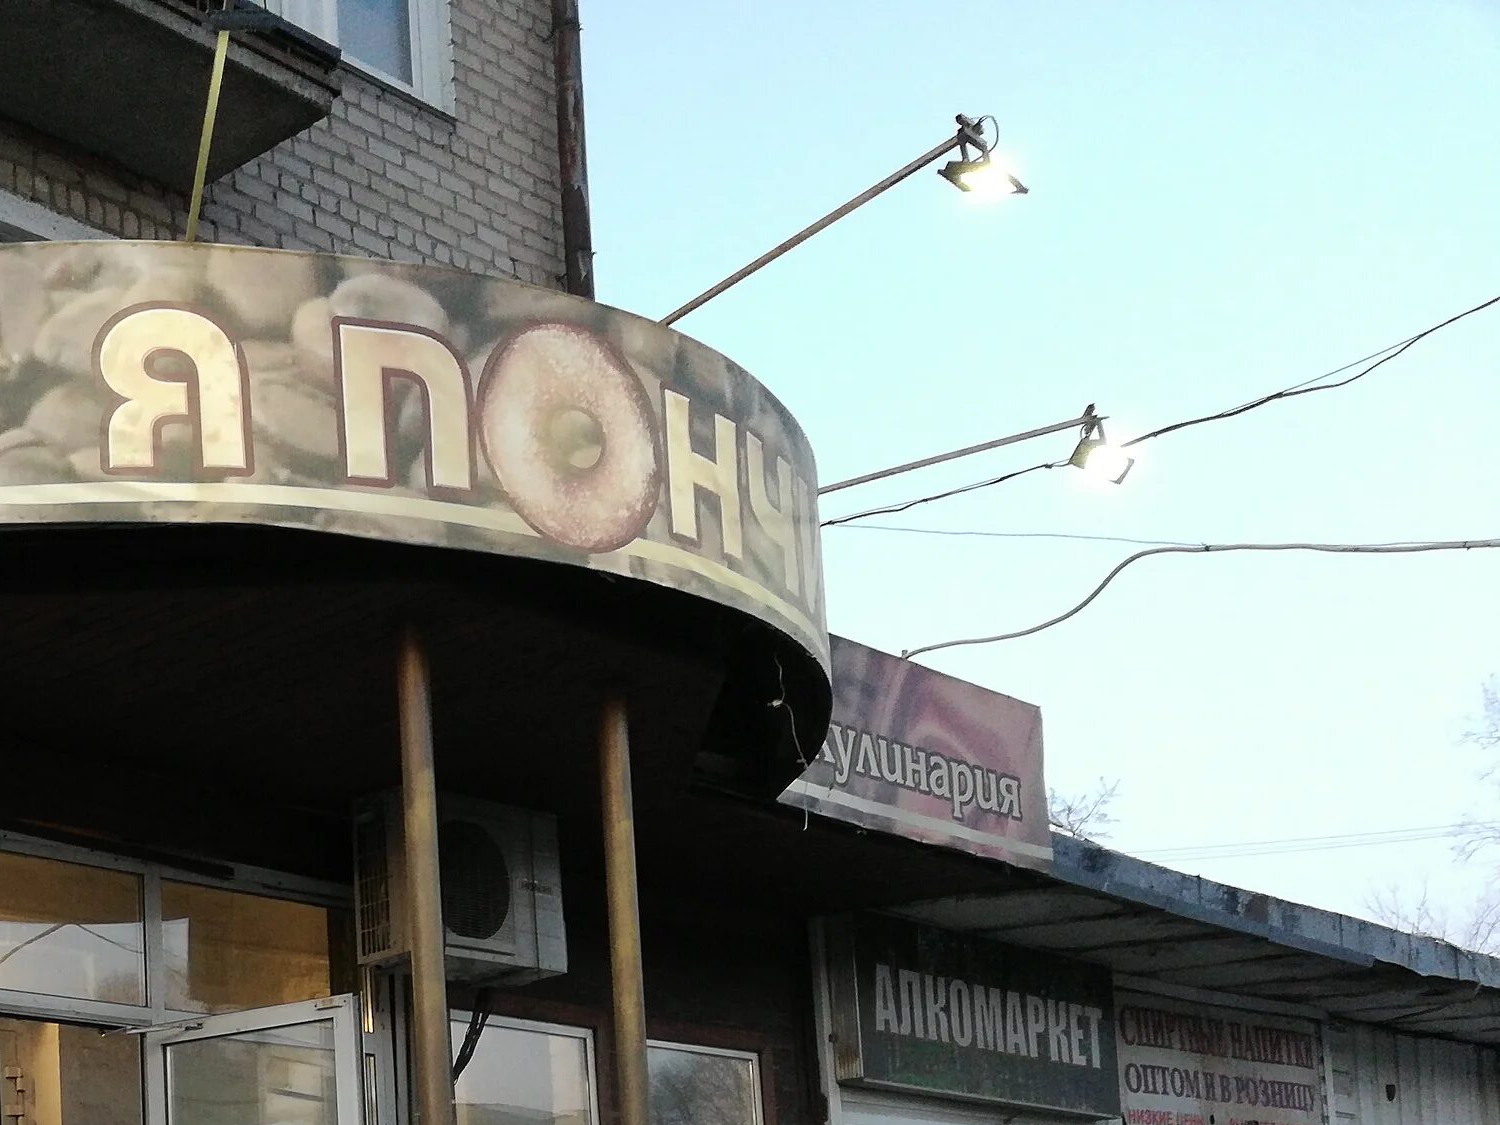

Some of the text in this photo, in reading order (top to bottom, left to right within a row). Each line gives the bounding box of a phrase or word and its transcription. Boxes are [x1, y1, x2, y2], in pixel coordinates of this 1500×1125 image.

[96, 302, 254, 477] Я
[875, 963, 1103, 1069] АЛКОМАРКЕТ
[1125, 1063, 1201, 1099] ОПТОМ
